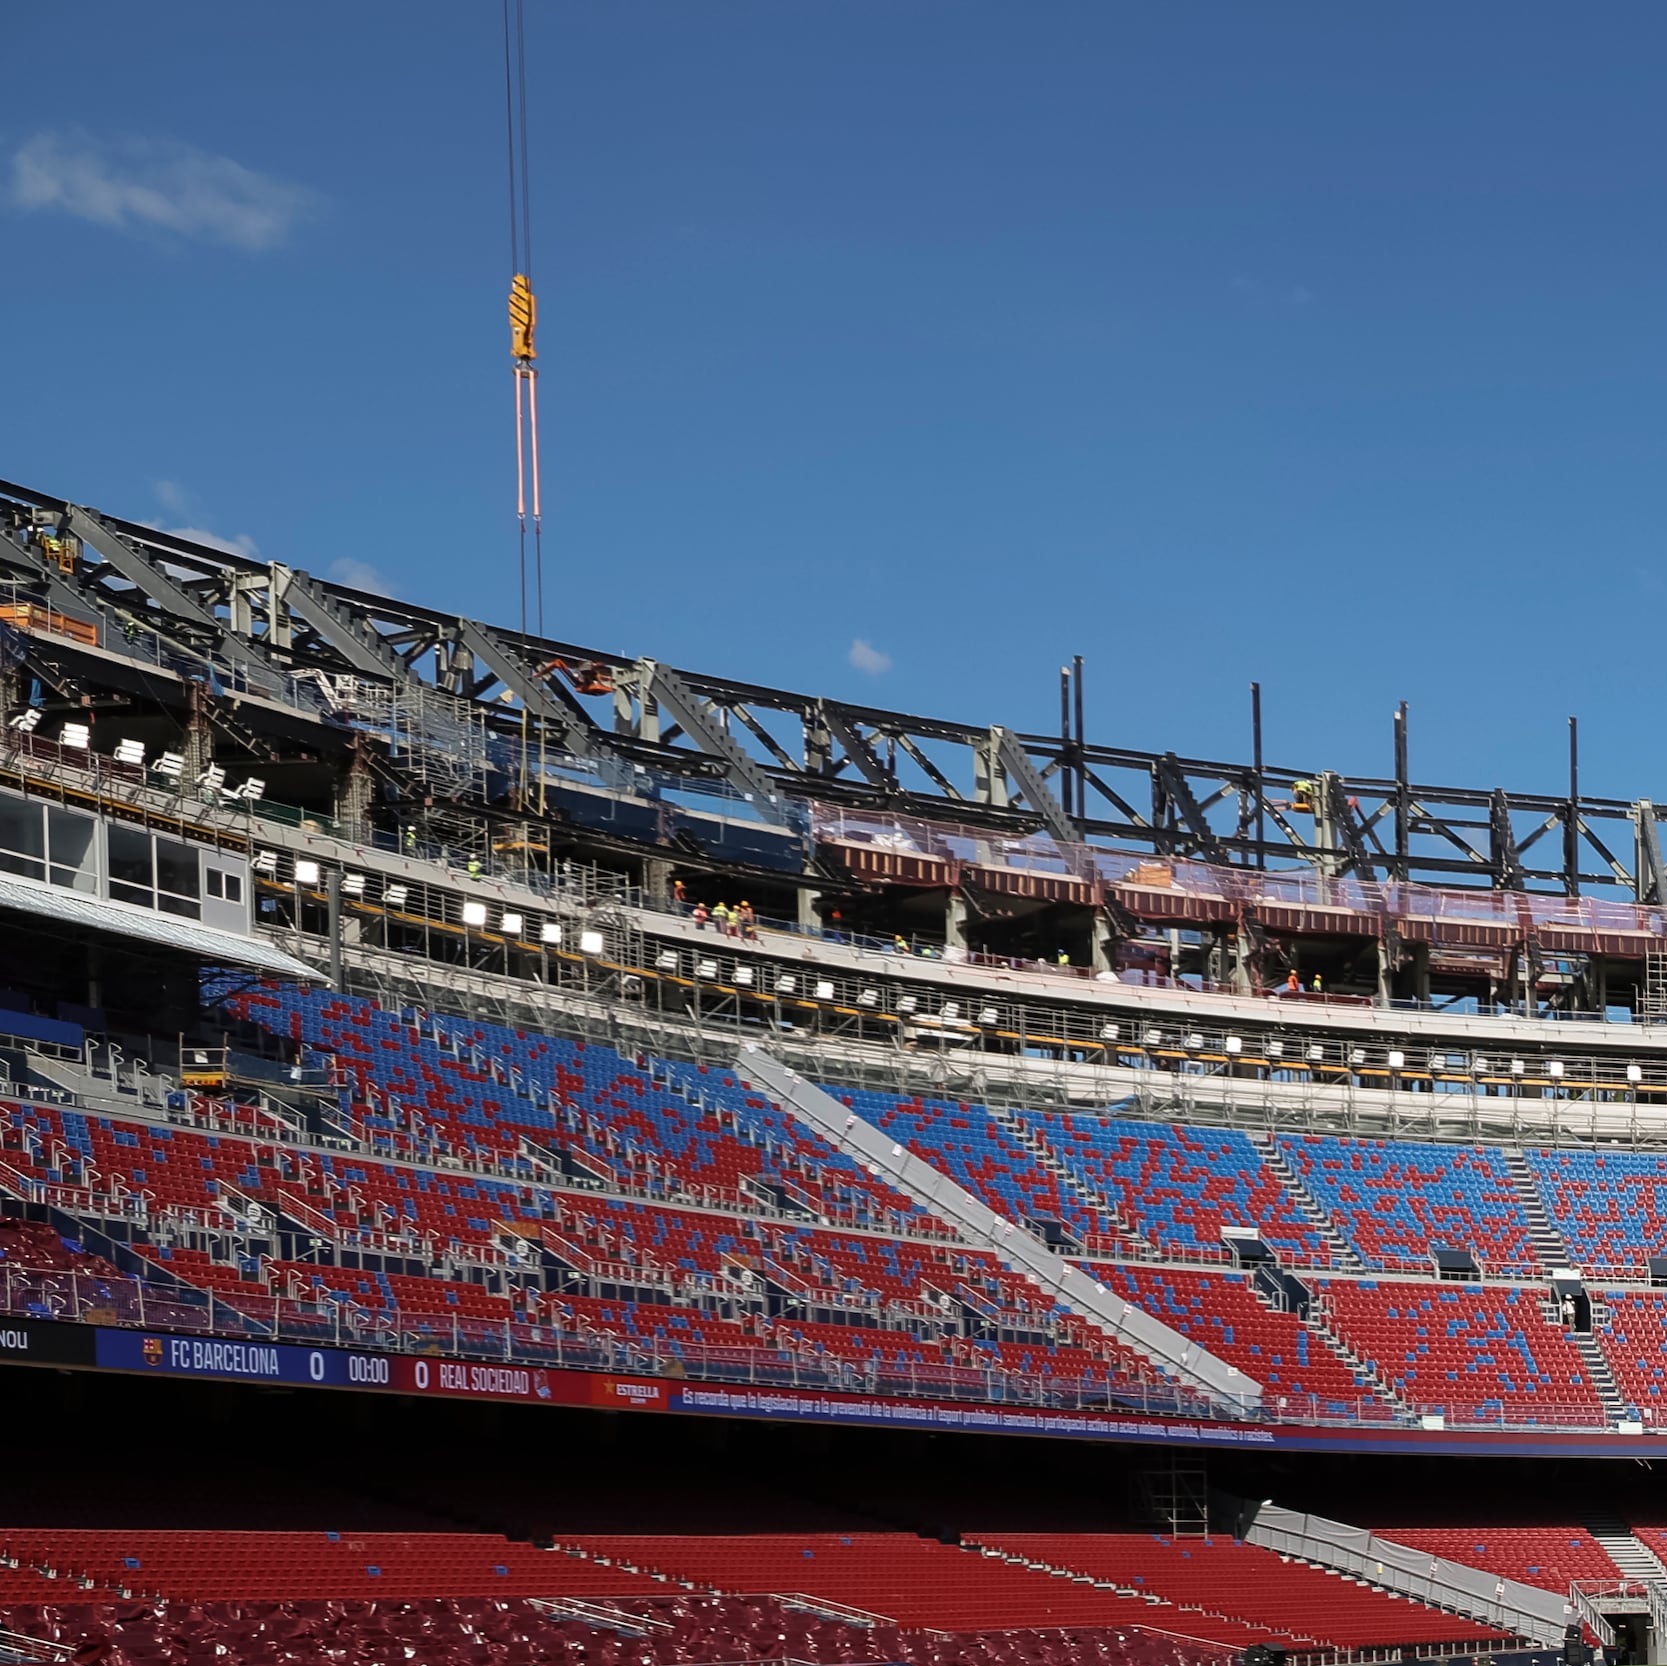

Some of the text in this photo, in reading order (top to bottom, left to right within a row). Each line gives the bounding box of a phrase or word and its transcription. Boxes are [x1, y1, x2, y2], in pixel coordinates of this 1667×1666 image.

[171, 1340, 529, 1395] FC BARCELONA 0 00:00 0 REAL SOCIEDAD
[616, 1383, 660, 1399] ESTRELLA
